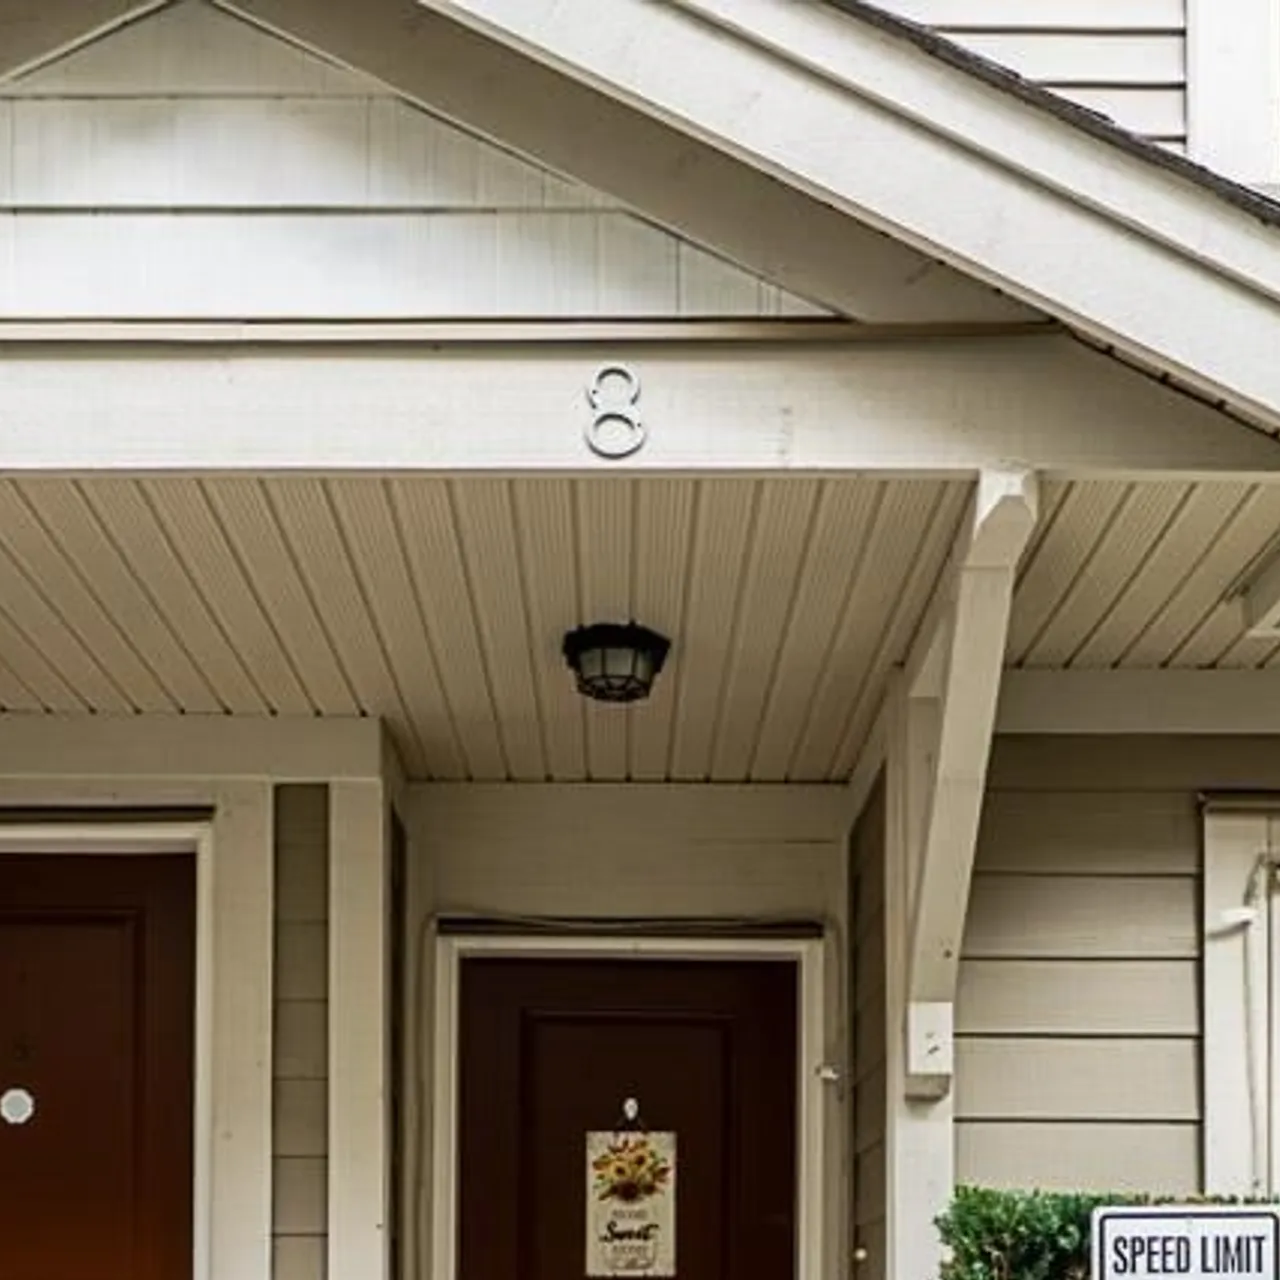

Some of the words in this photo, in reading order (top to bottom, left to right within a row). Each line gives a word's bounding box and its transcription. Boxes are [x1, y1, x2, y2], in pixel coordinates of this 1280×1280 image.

[583, 362, 647, 461] 8
[1113, 1236, 1191, 1274] SPEED
[1200, 1235, 1266, 1274] LIMIT
